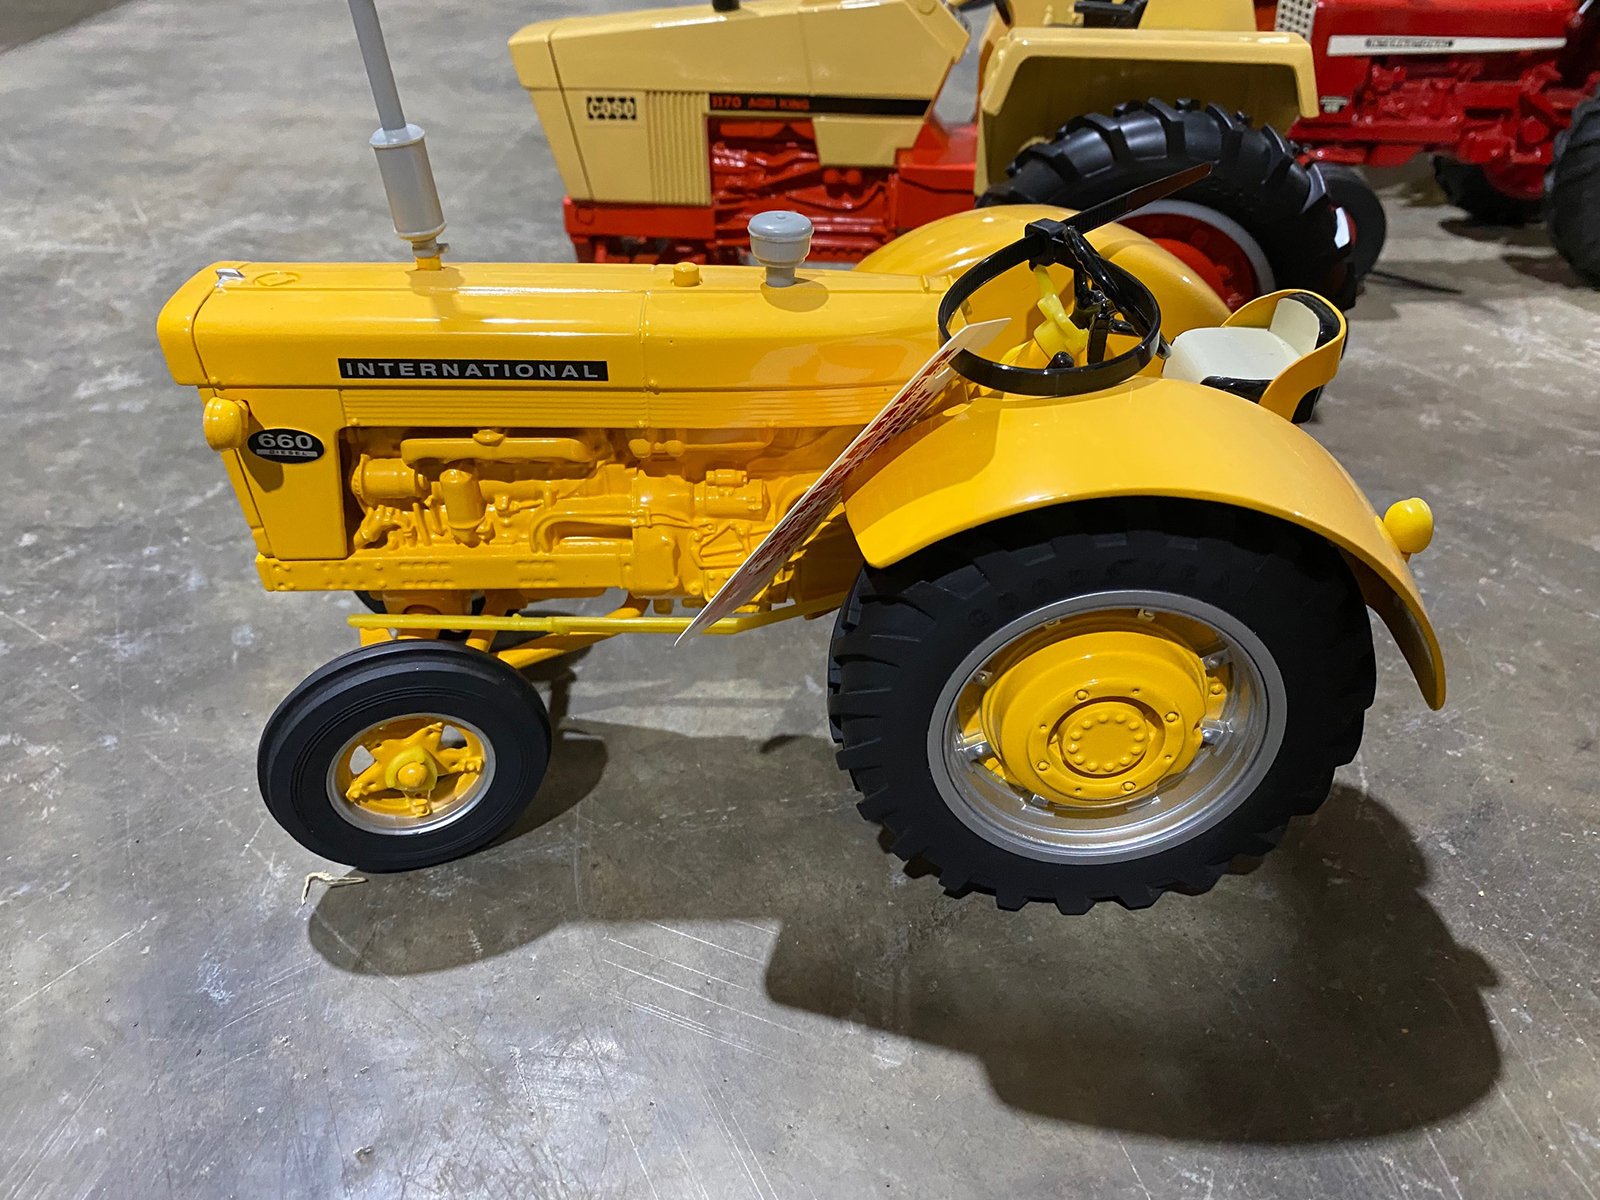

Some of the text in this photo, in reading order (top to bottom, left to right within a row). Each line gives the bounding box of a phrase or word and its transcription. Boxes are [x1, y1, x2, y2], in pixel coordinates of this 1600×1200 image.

[345, 362, 599, 378] INTERNATIONAL
[257, 433, 313, 450] 660
[269, 449, 308, 457] DIESEL
